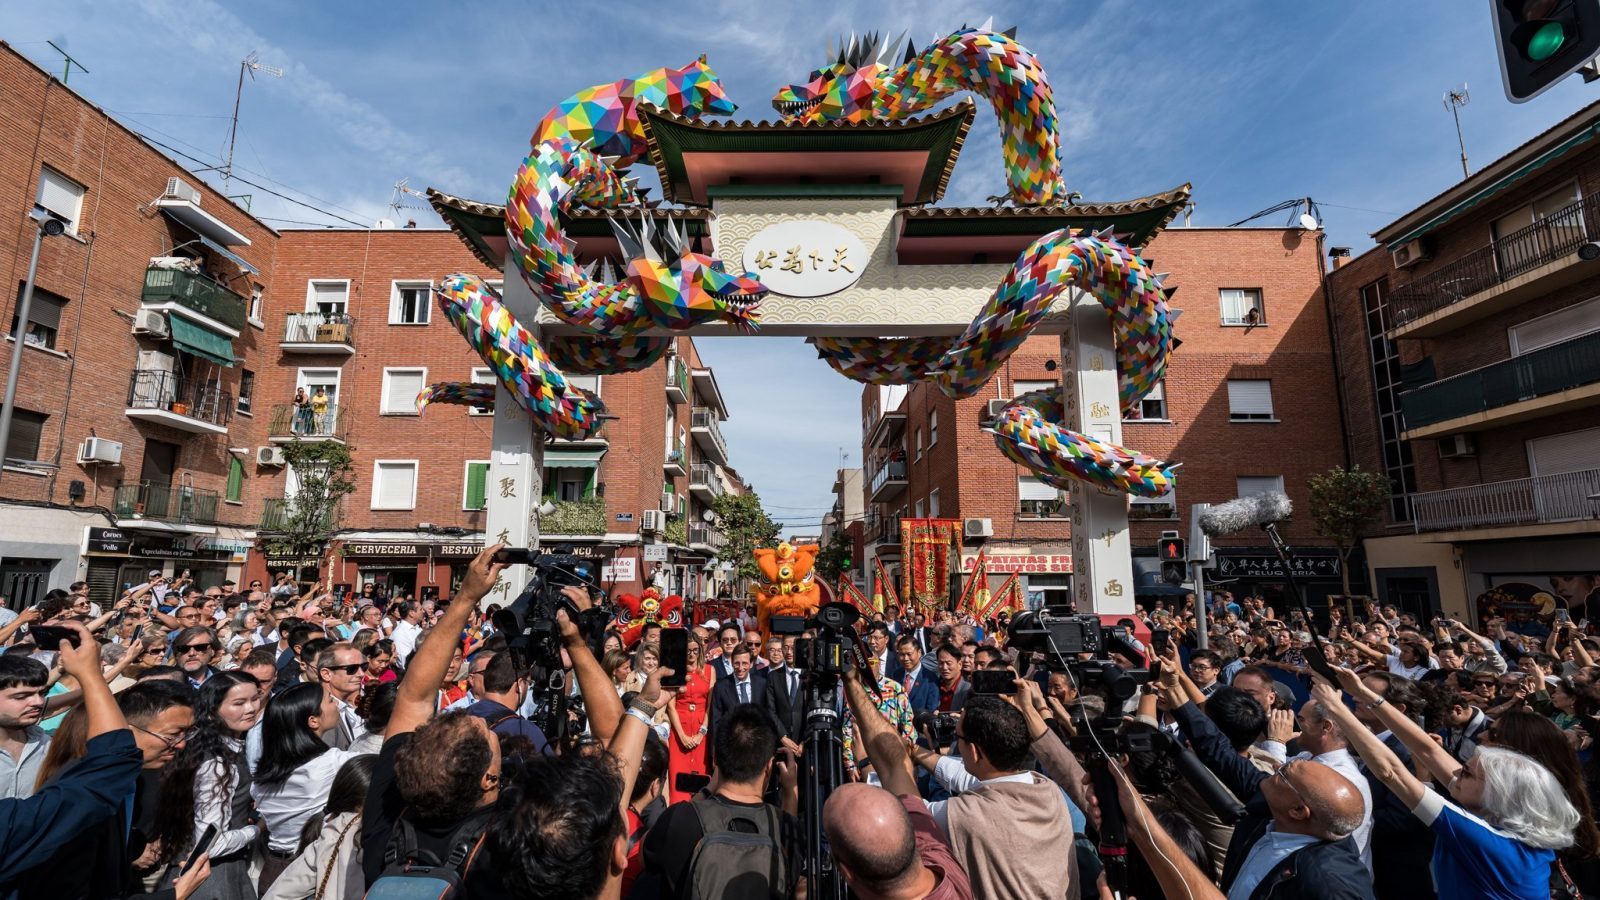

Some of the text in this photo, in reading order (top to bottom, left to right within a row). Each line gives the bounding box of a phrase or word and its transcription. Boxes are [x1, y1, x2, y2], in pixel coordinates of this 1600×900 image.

[102, 530, 122, 539] Carnes
[102, 543, 118, 551] Pollo
[355, 545, 417, 554] CERVECERIA
[984, 555, 1072, 564] PATATAS FR
[986, 564, 1047, 572] FRUTOS
[852, 644, 866, 669] Canon
